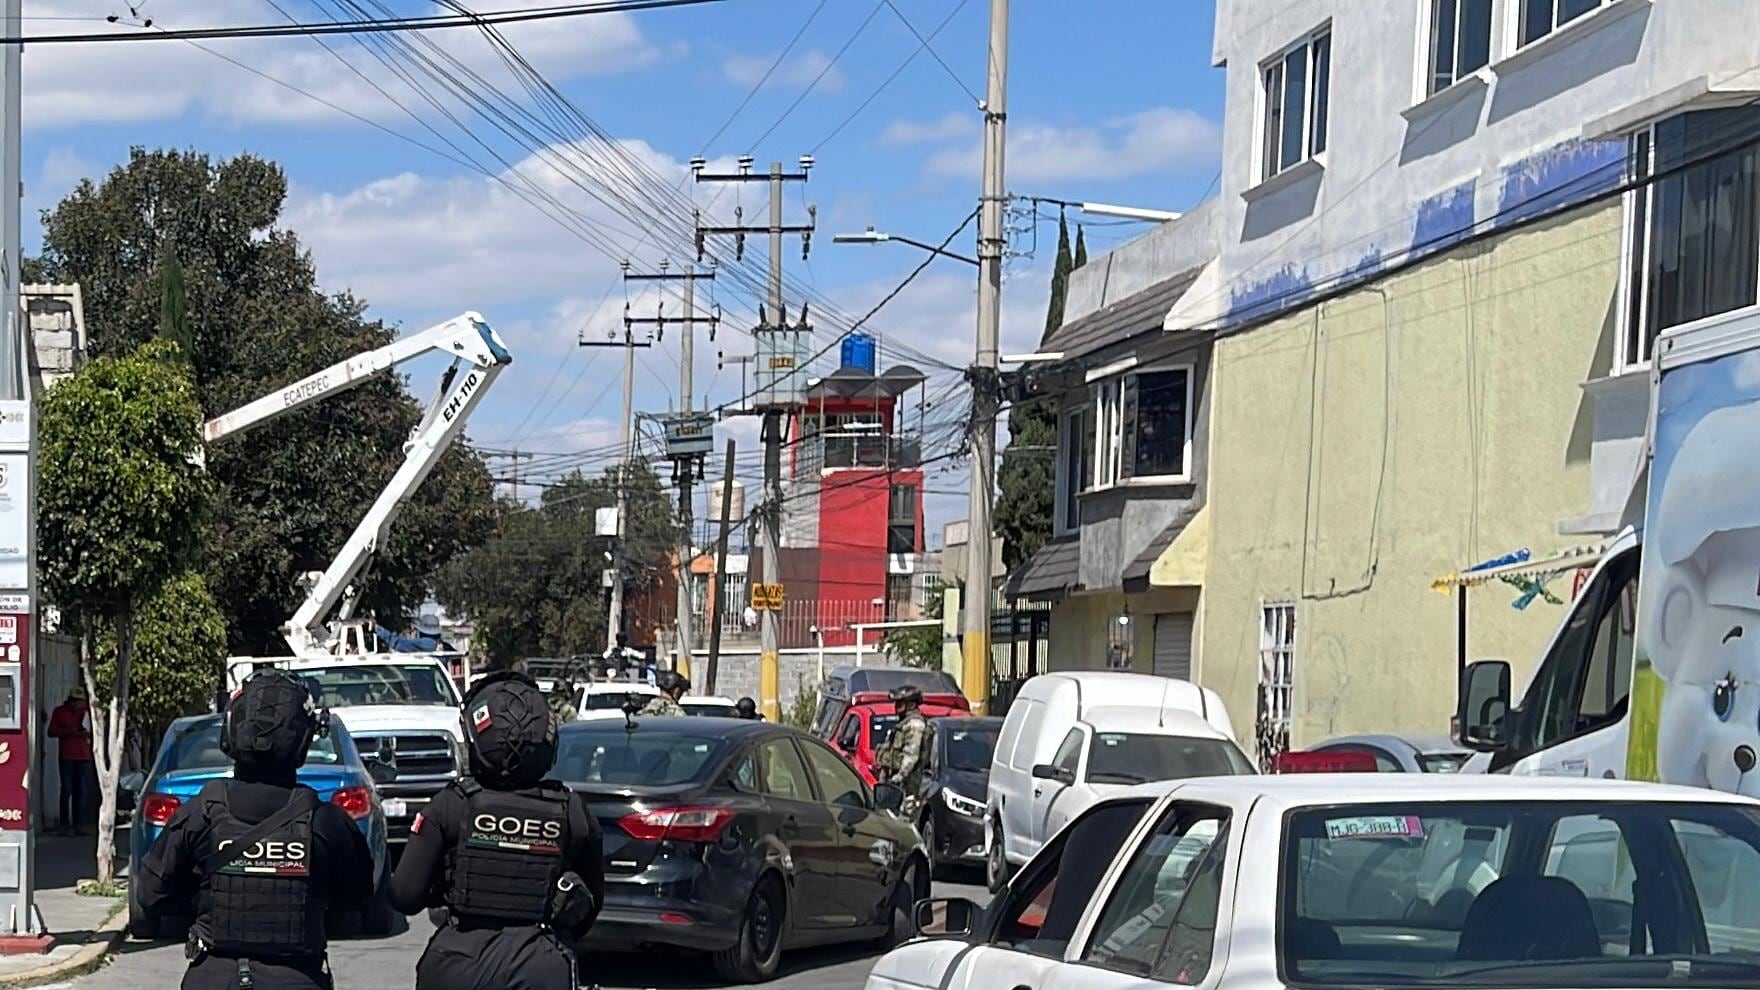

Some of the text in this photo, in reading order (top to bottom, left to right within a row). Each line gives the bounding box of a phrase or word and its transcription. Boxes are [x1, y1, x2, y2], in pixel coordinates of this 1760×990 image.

[283, 375, 329, 406] ECATEPEC
[443, 373, 477, 422] EH-110
[474, 813, 561, 839] GOES
